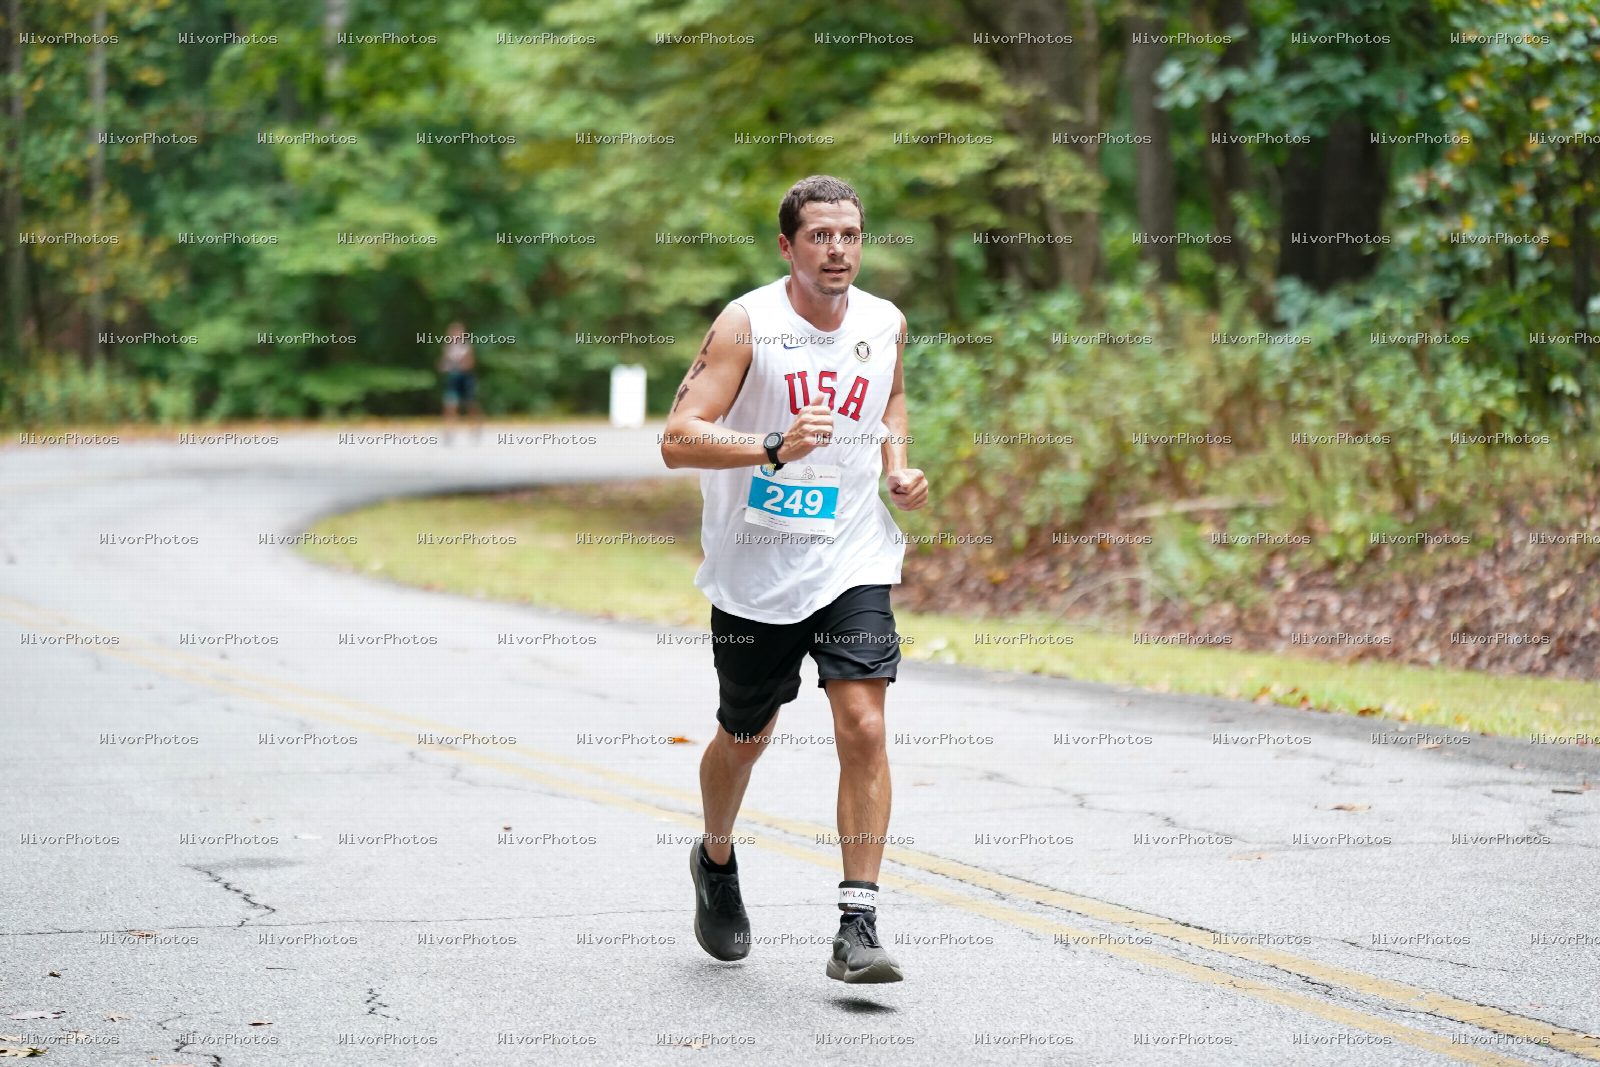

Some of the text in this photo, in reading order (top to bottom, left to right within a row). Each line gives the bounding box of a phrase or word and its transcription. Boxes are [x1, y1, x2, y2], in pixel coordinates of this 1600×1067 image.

[784, 370, 870, 422] USA
[763, 485, 824, 516] 249
[842, 890, 875, 900] MYLAPS
